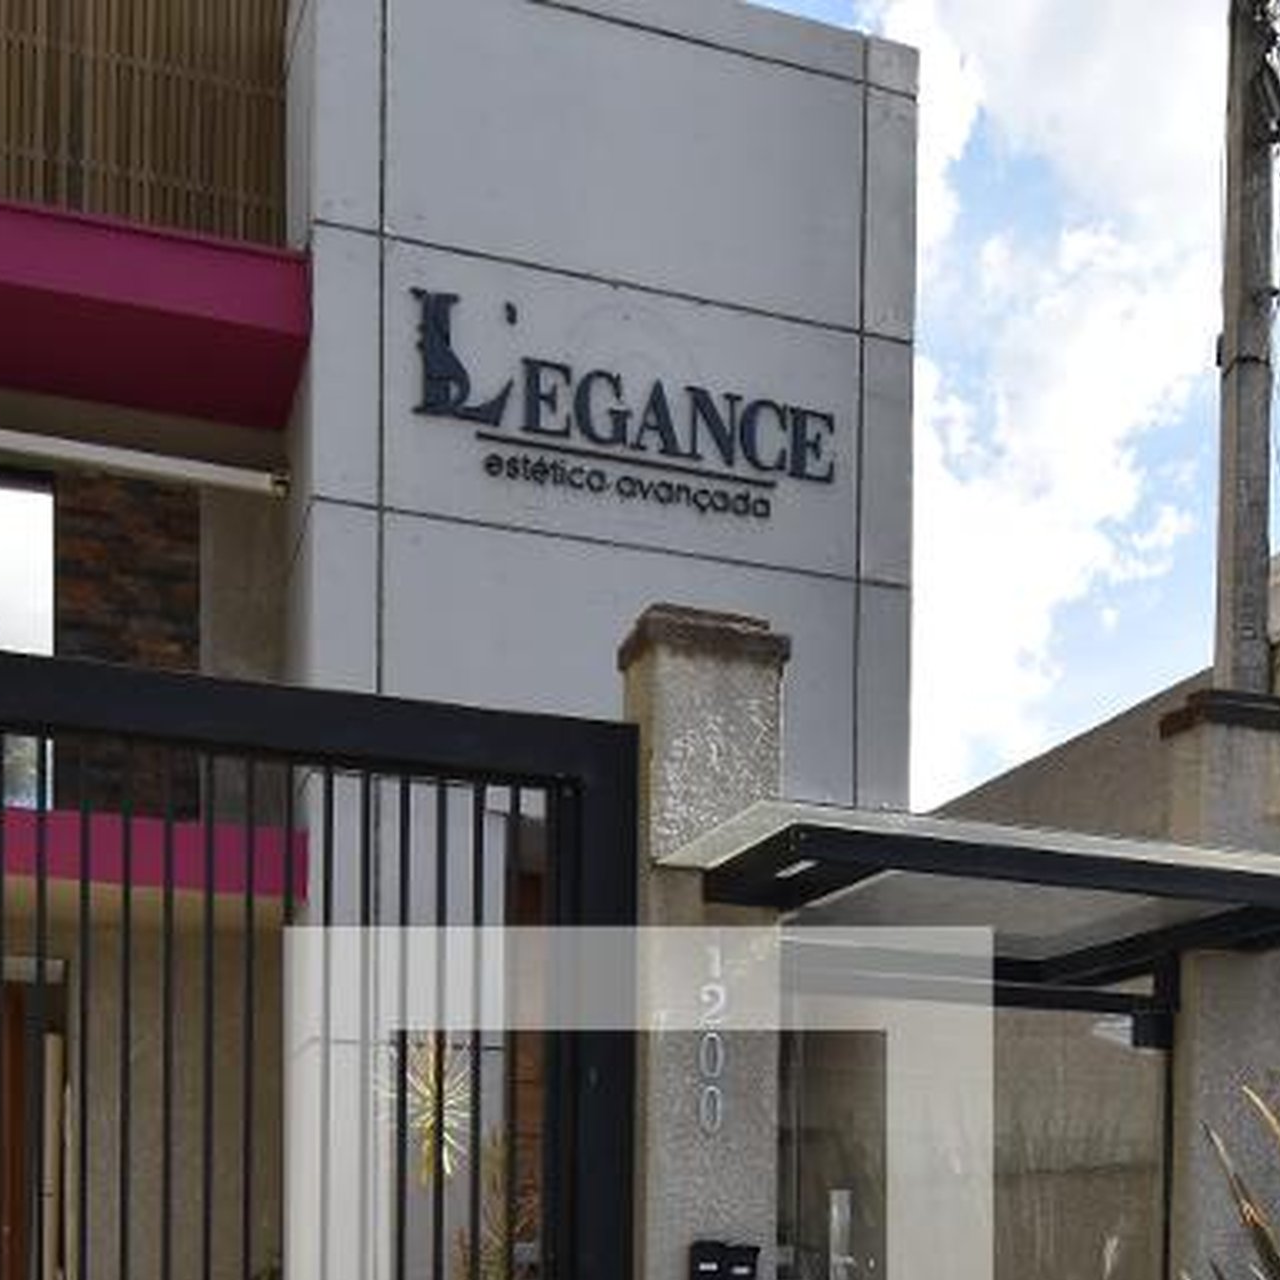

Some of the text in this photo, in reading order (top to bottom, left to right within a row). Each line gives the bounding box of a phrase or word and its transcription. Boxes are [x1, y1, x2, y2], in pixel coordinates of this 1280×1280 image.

[410, 287, 836, 485] L'EGANCE
[483, 453, 772, 520] estética avançada
[698, 945, 726, 1136] 1200
